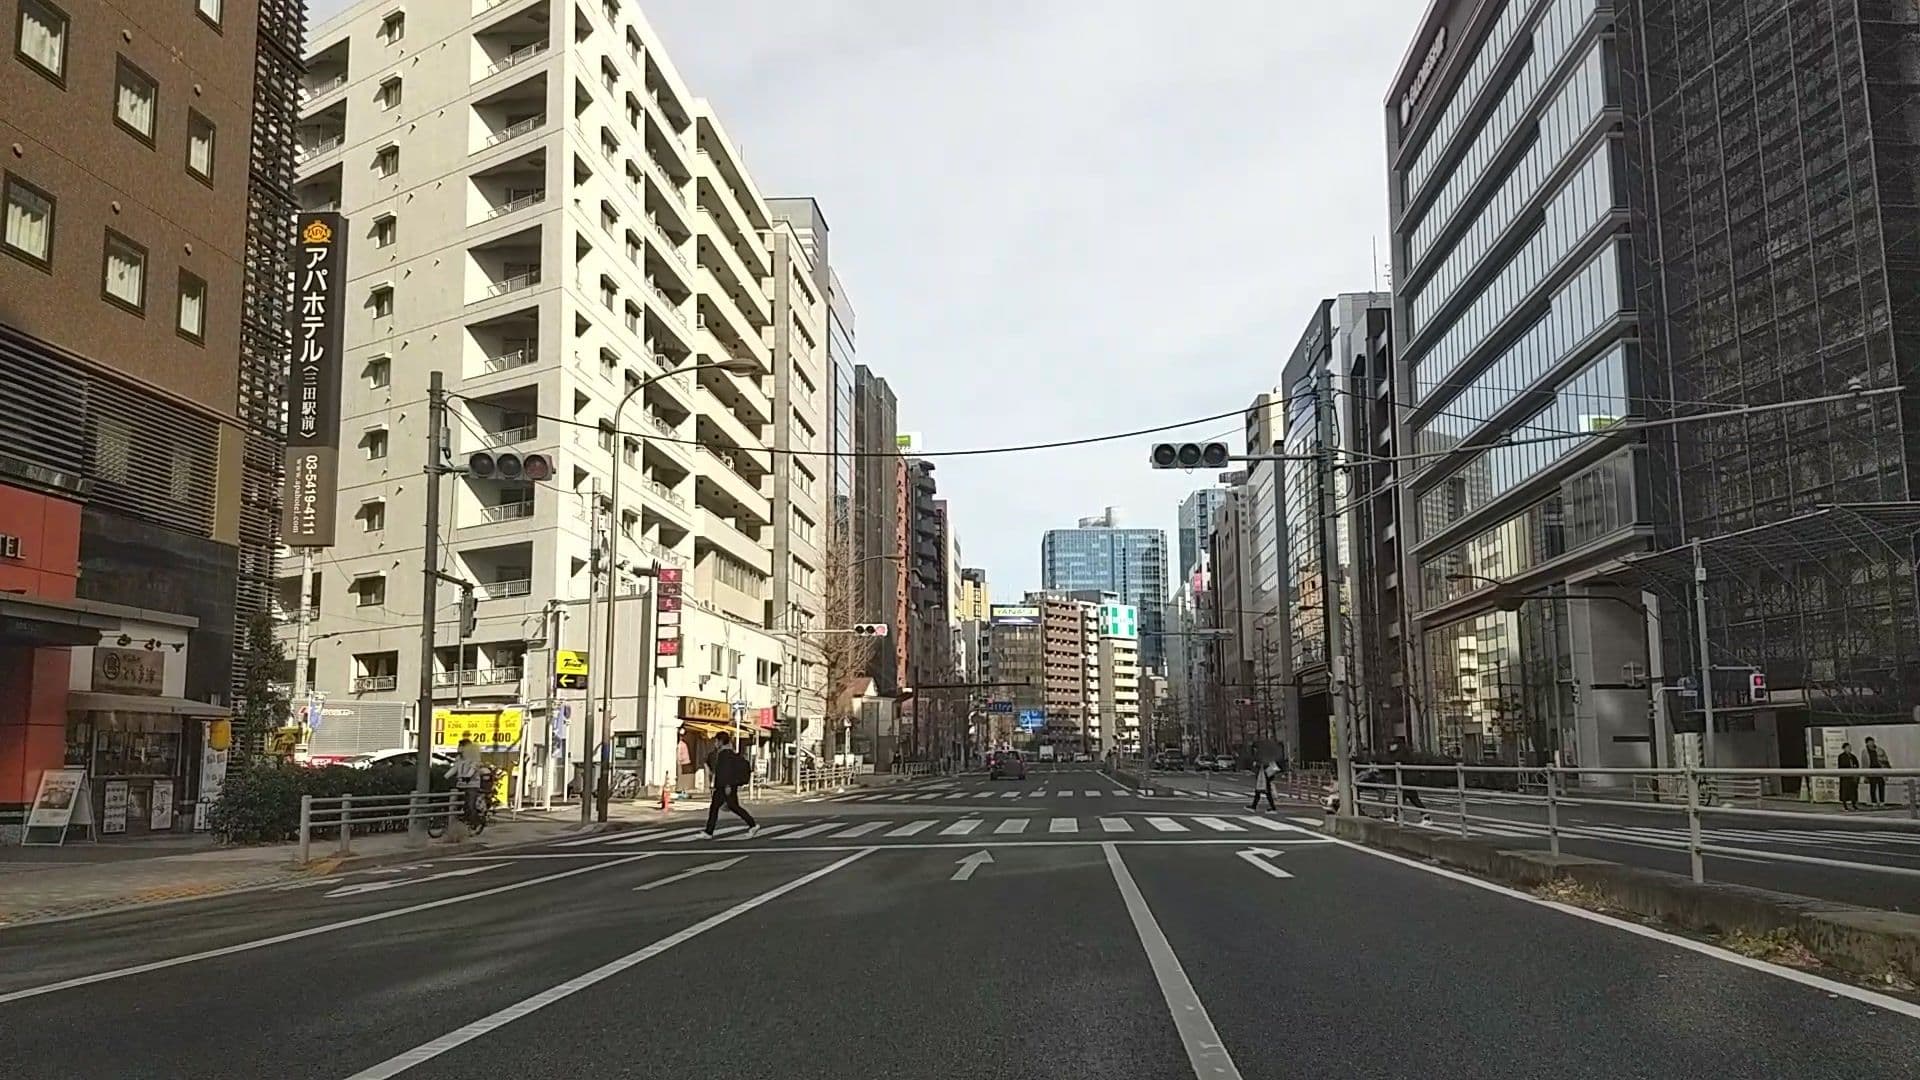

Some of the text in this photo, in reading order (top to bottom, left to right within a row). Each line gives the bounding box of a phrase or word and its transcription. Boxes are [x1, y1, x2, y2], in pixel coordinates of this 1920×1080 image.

[300, 247, 328, 362] アパホテル
[292, 458, 301, 534] www.apahotel.com
[302, 454, 318, 535] 03-5419-4111
